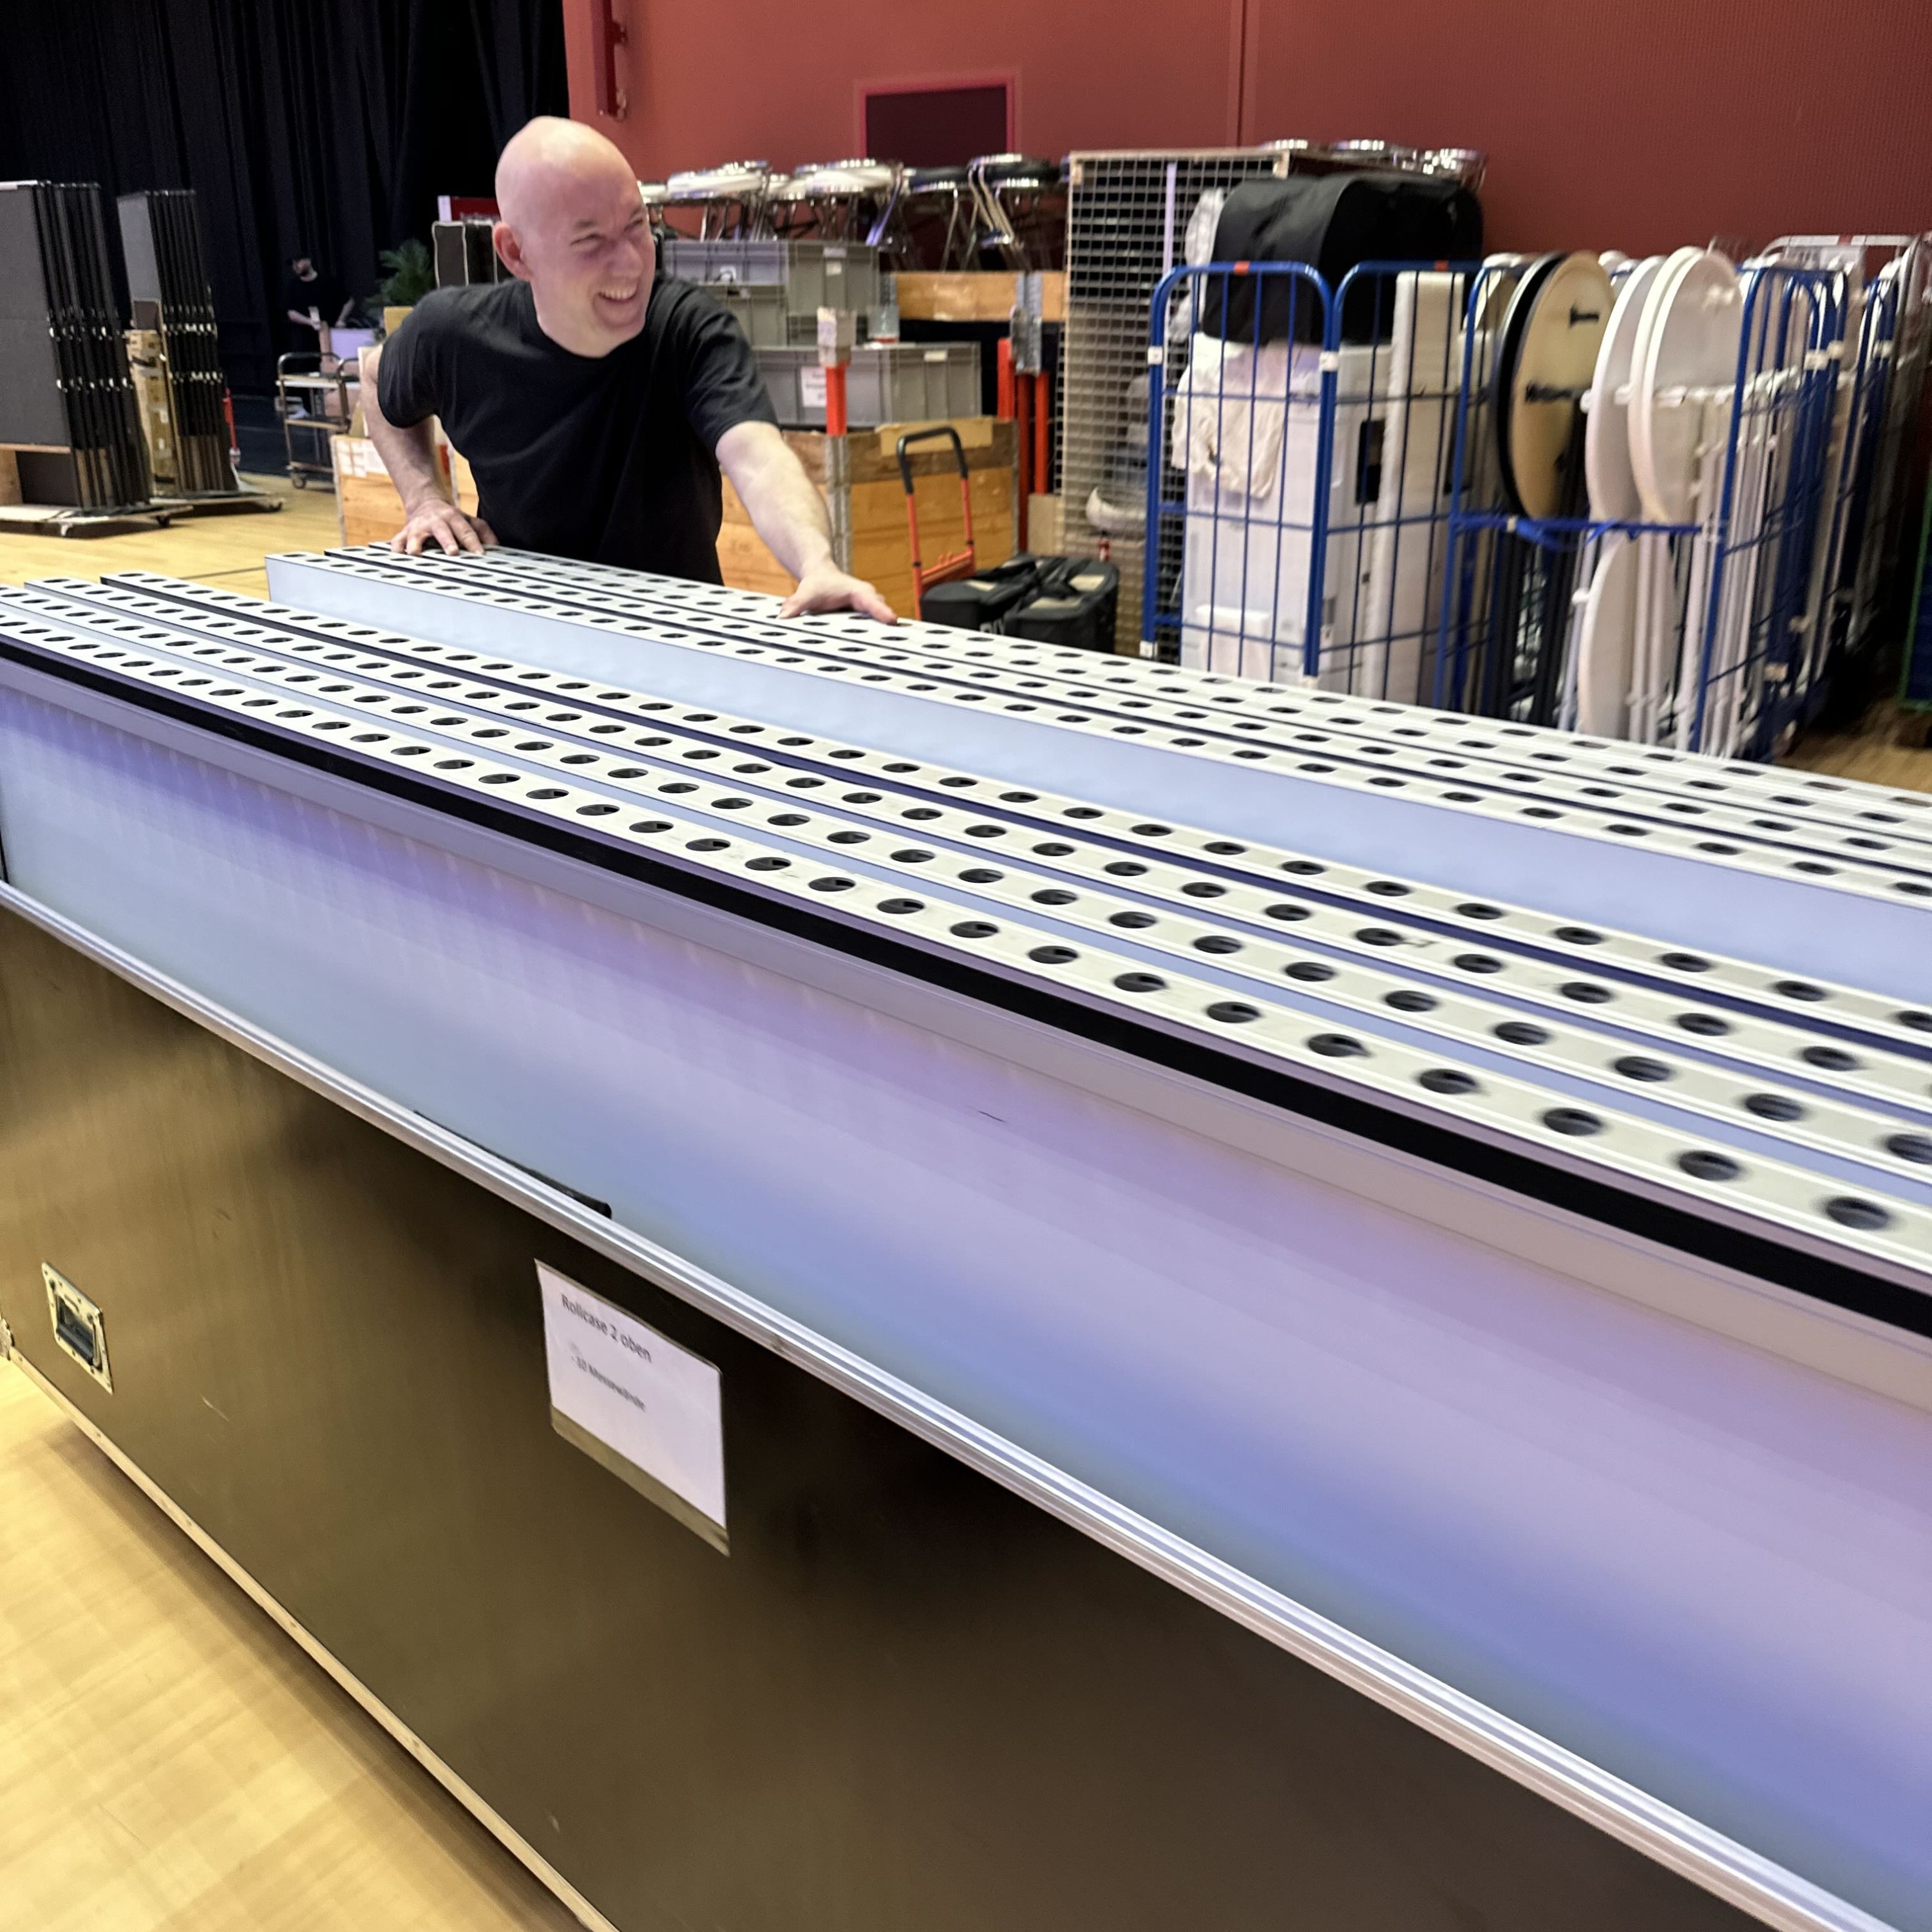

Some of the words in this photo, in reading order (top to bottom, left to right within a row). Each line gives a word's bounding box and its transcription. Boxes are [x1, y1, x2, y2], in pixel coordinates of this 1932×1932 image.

[562, 1293, 608, 1336] Rollcase
[609, 1323, 618, 1343] 2
[620, 1334, 652, 1363] oben
